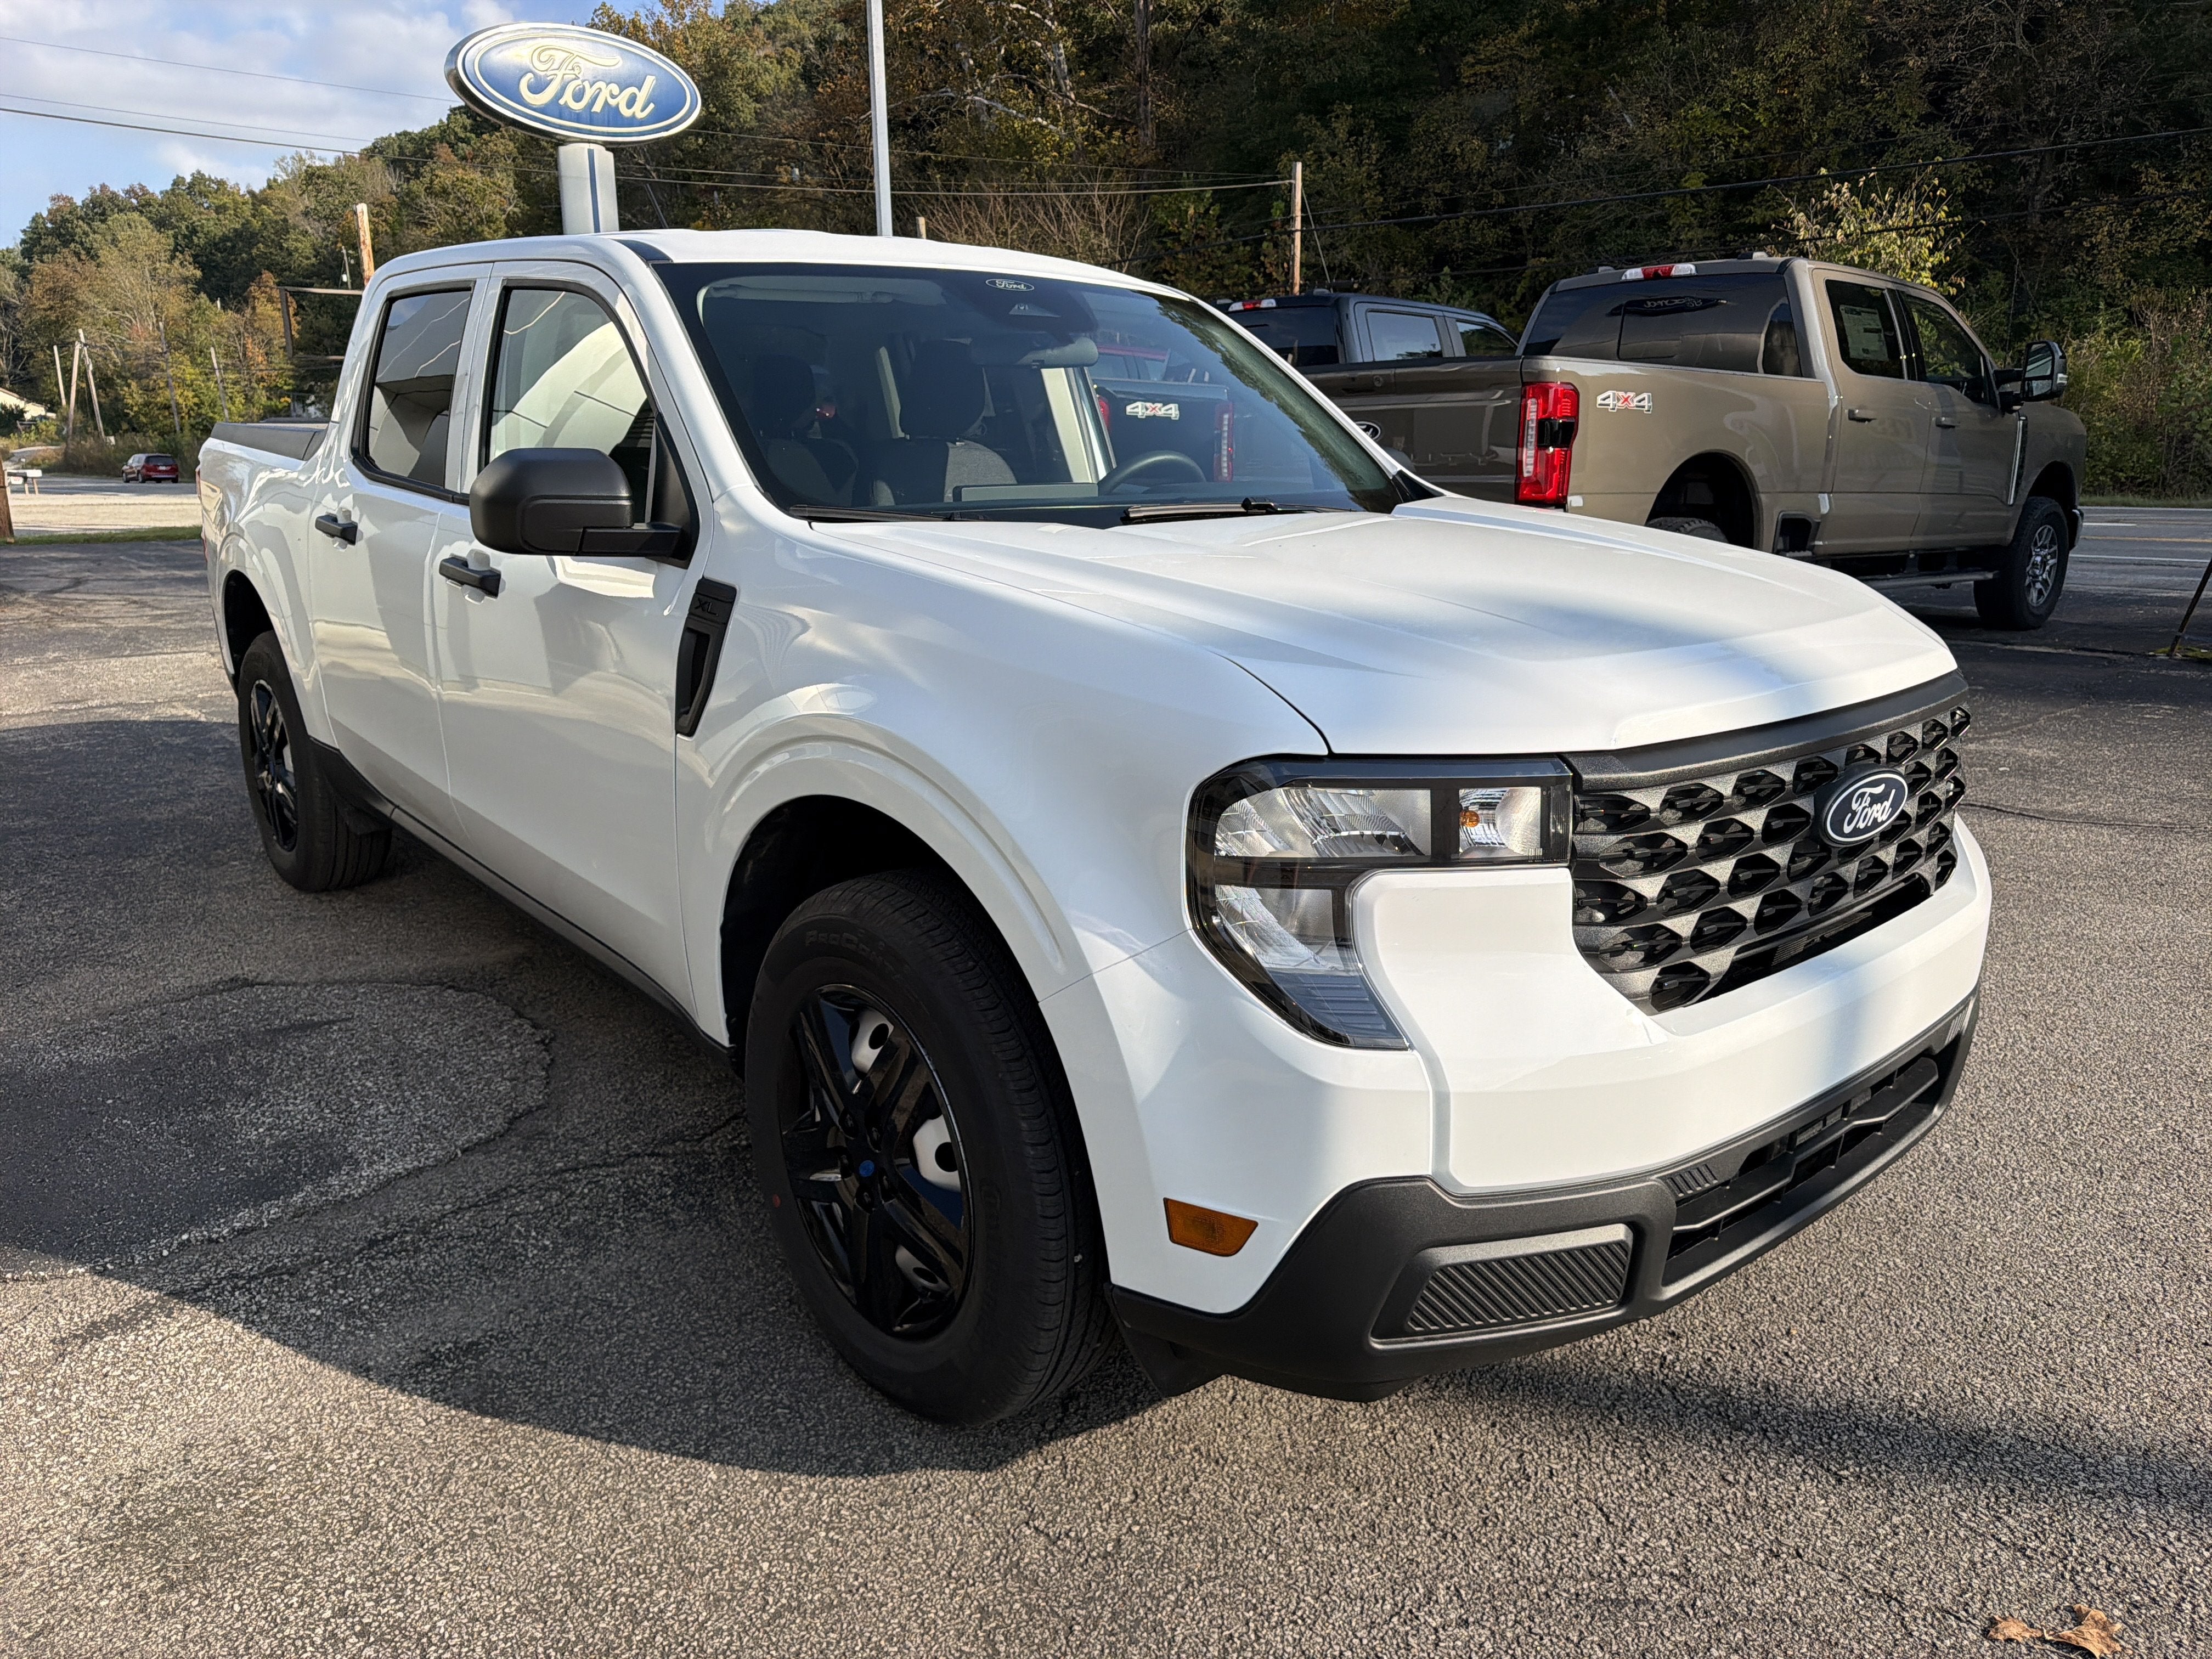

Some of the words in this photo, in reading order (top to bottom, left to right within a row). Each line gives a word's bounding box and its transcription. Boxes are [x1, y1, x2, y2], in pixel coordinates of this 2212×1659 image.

[519, 45, 657, 119] Ford
[996, 280, 1027, 290] Ford
[695, 597, 718, 616] XL
[1843, 783, 1896, 833] Ford
